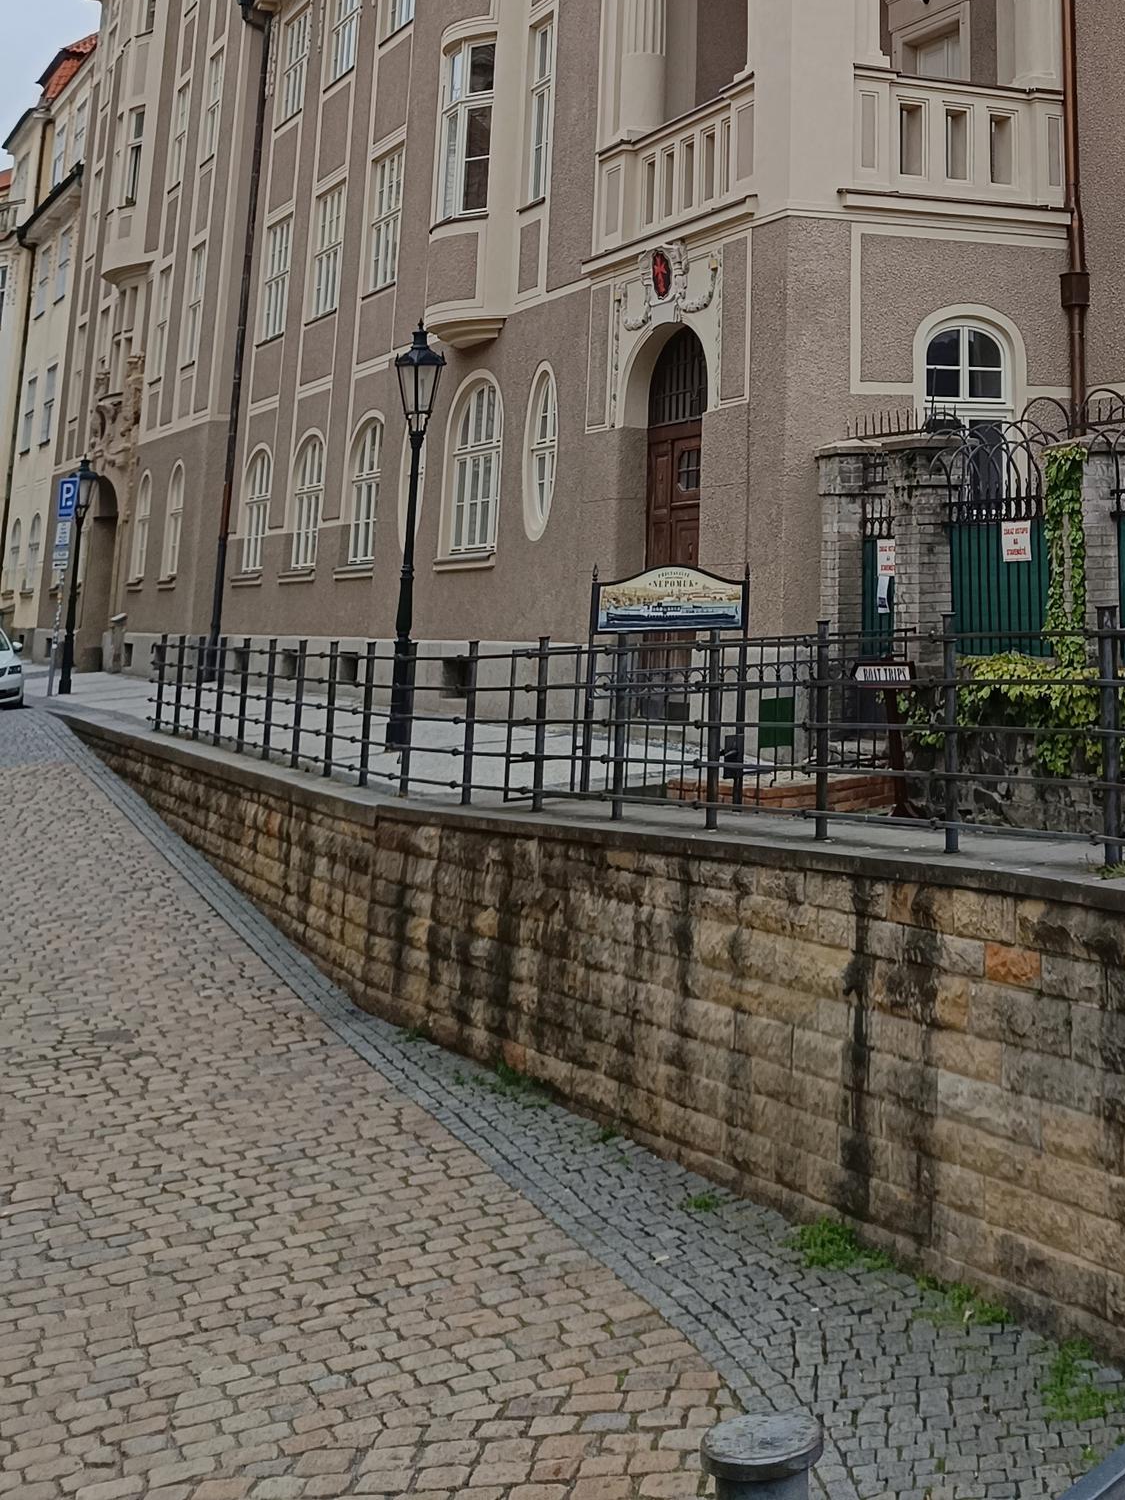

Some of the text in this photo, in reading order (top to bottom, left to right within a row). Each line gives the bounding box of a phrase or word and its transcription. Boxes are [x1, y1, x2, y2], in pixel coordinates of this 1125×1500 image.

[61, 483, 74, 507] P
[863, 667, 907, 681] BOAT TRIPS
